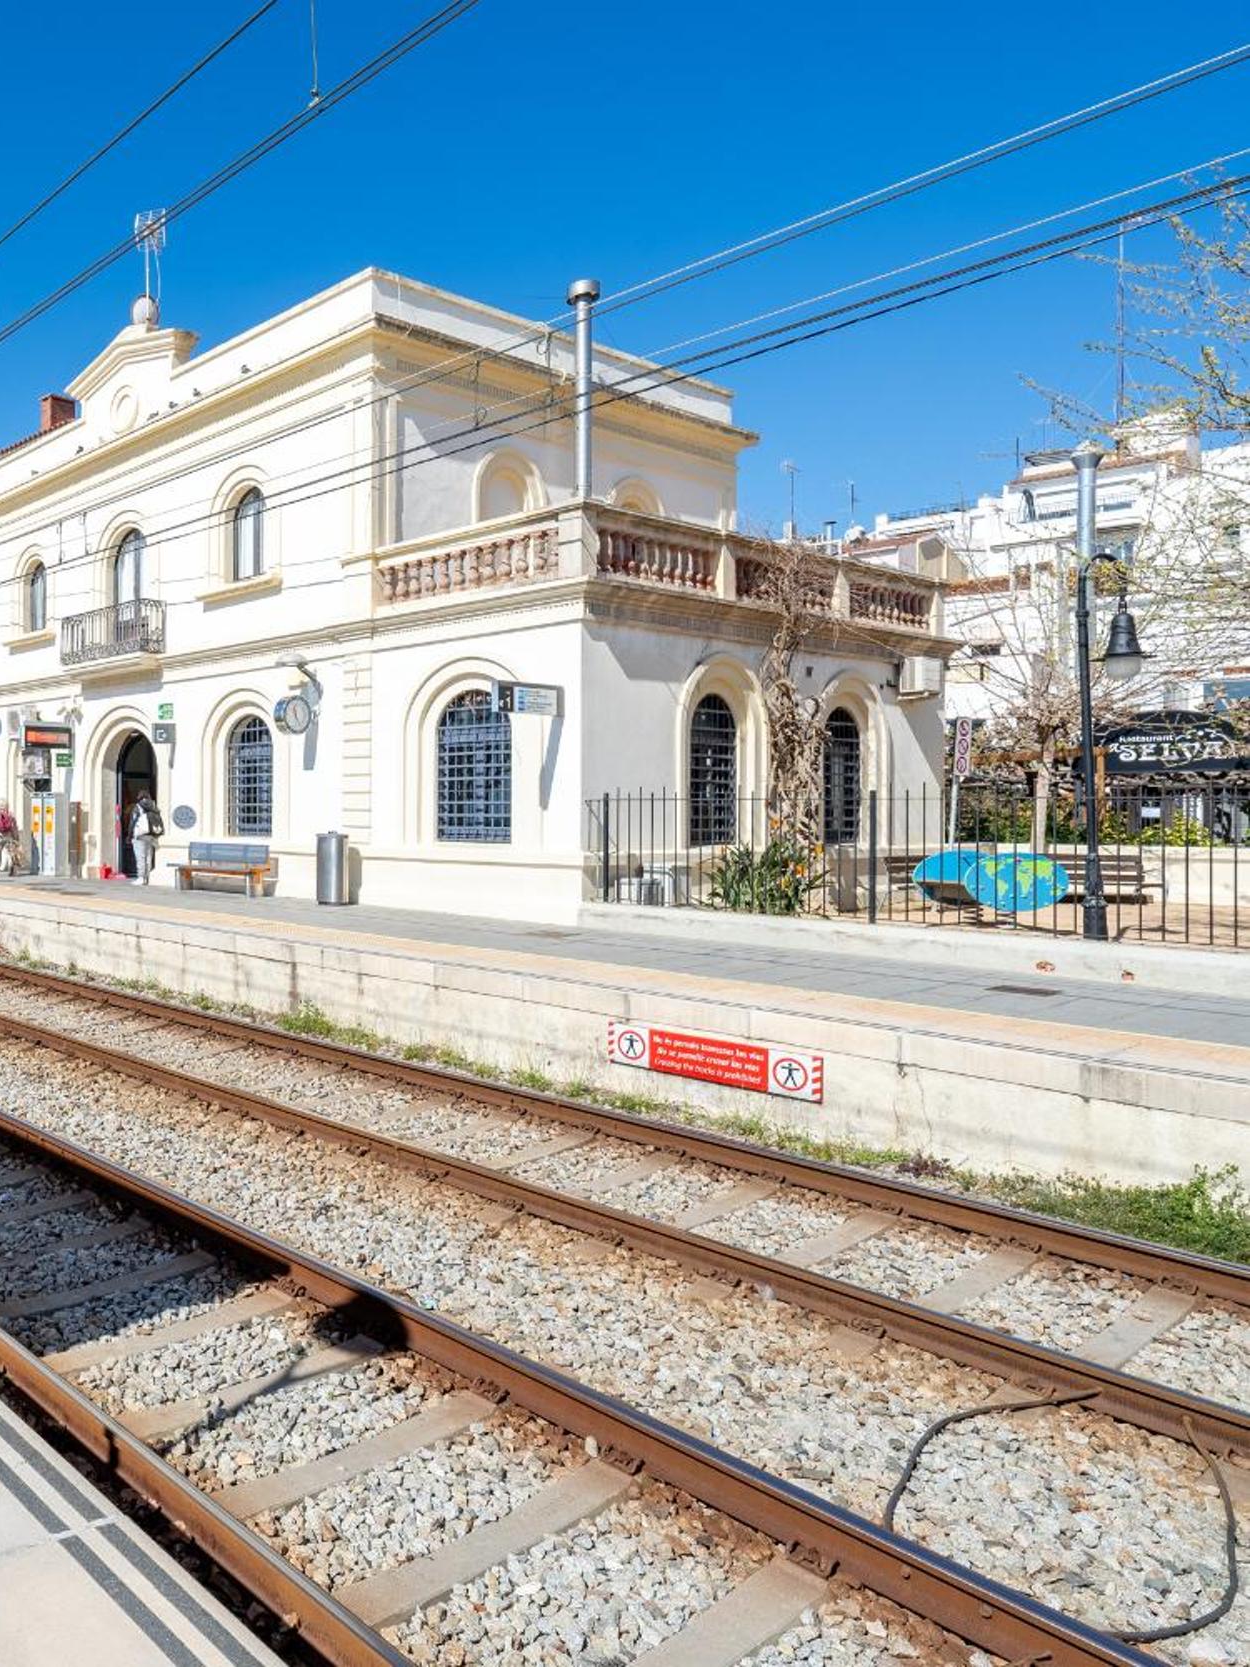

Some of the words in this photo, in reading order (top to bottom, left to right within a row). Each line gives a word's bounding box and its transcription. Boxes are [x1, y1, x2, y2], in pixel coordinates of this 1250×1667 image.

[1119, 734, 1173, 743] Restaurant
[1119, 741, 1228, 760] SELVA
[724, 1070, 762, 1084] prohibited
